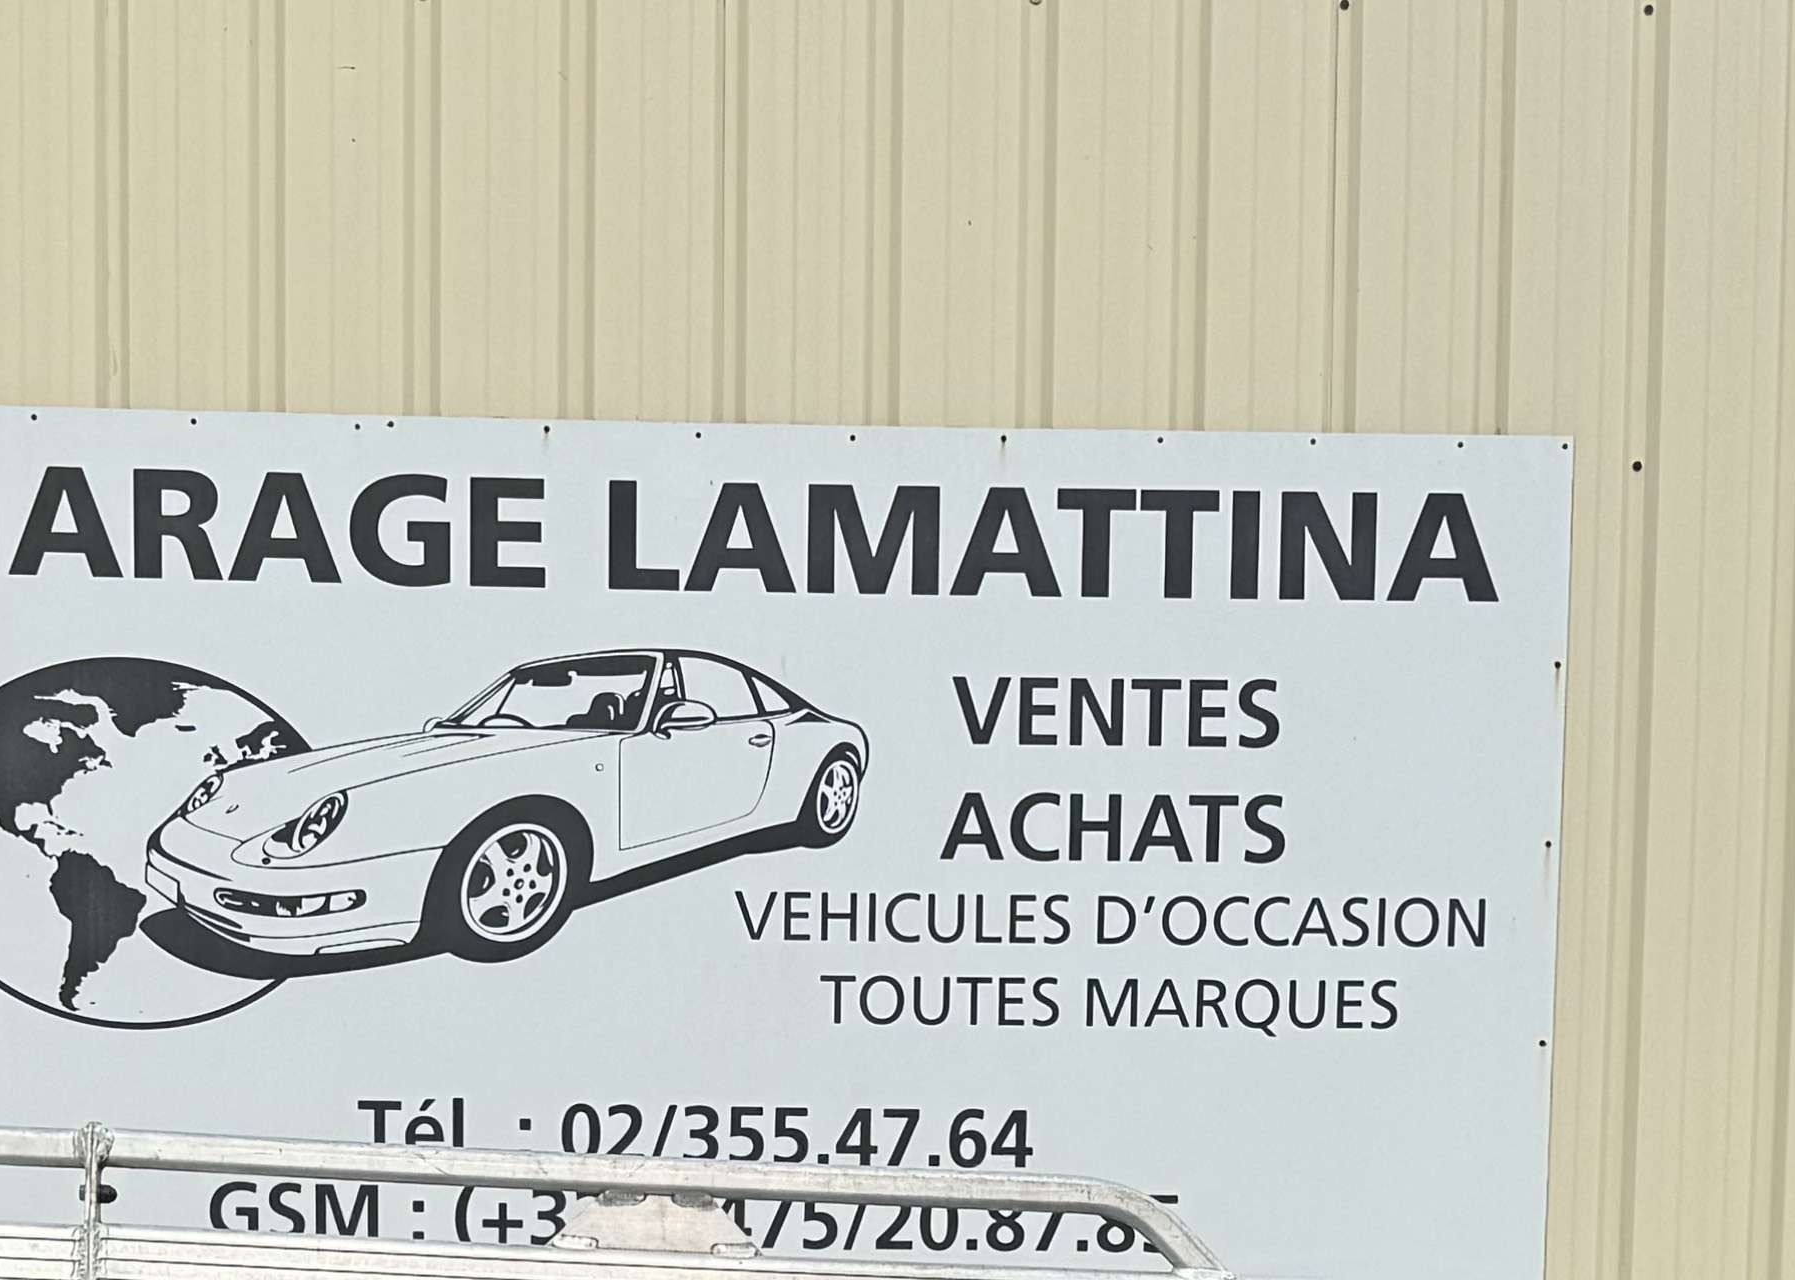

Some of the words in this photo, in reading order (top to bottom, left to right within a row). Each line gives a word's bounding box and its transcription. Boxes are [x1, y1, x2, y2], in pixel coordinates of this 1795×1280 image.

[608, 476, 1499, 603] LAMATTINA
[952, 676, 1281, 750] VENTES
[940, 791, 1287, 865] ACHATS
[734, 890, 1072, 946] VEHICULES
[820, 974, 1061, 1028] TOUTES
[1085, 977, 1399, 1038] MARQUES
[357, 1097, 466, 1147] Tél
[561, 1103, 1034, 1168] 02/355.47.64
[209, 1181, 379, 1238] GSM
